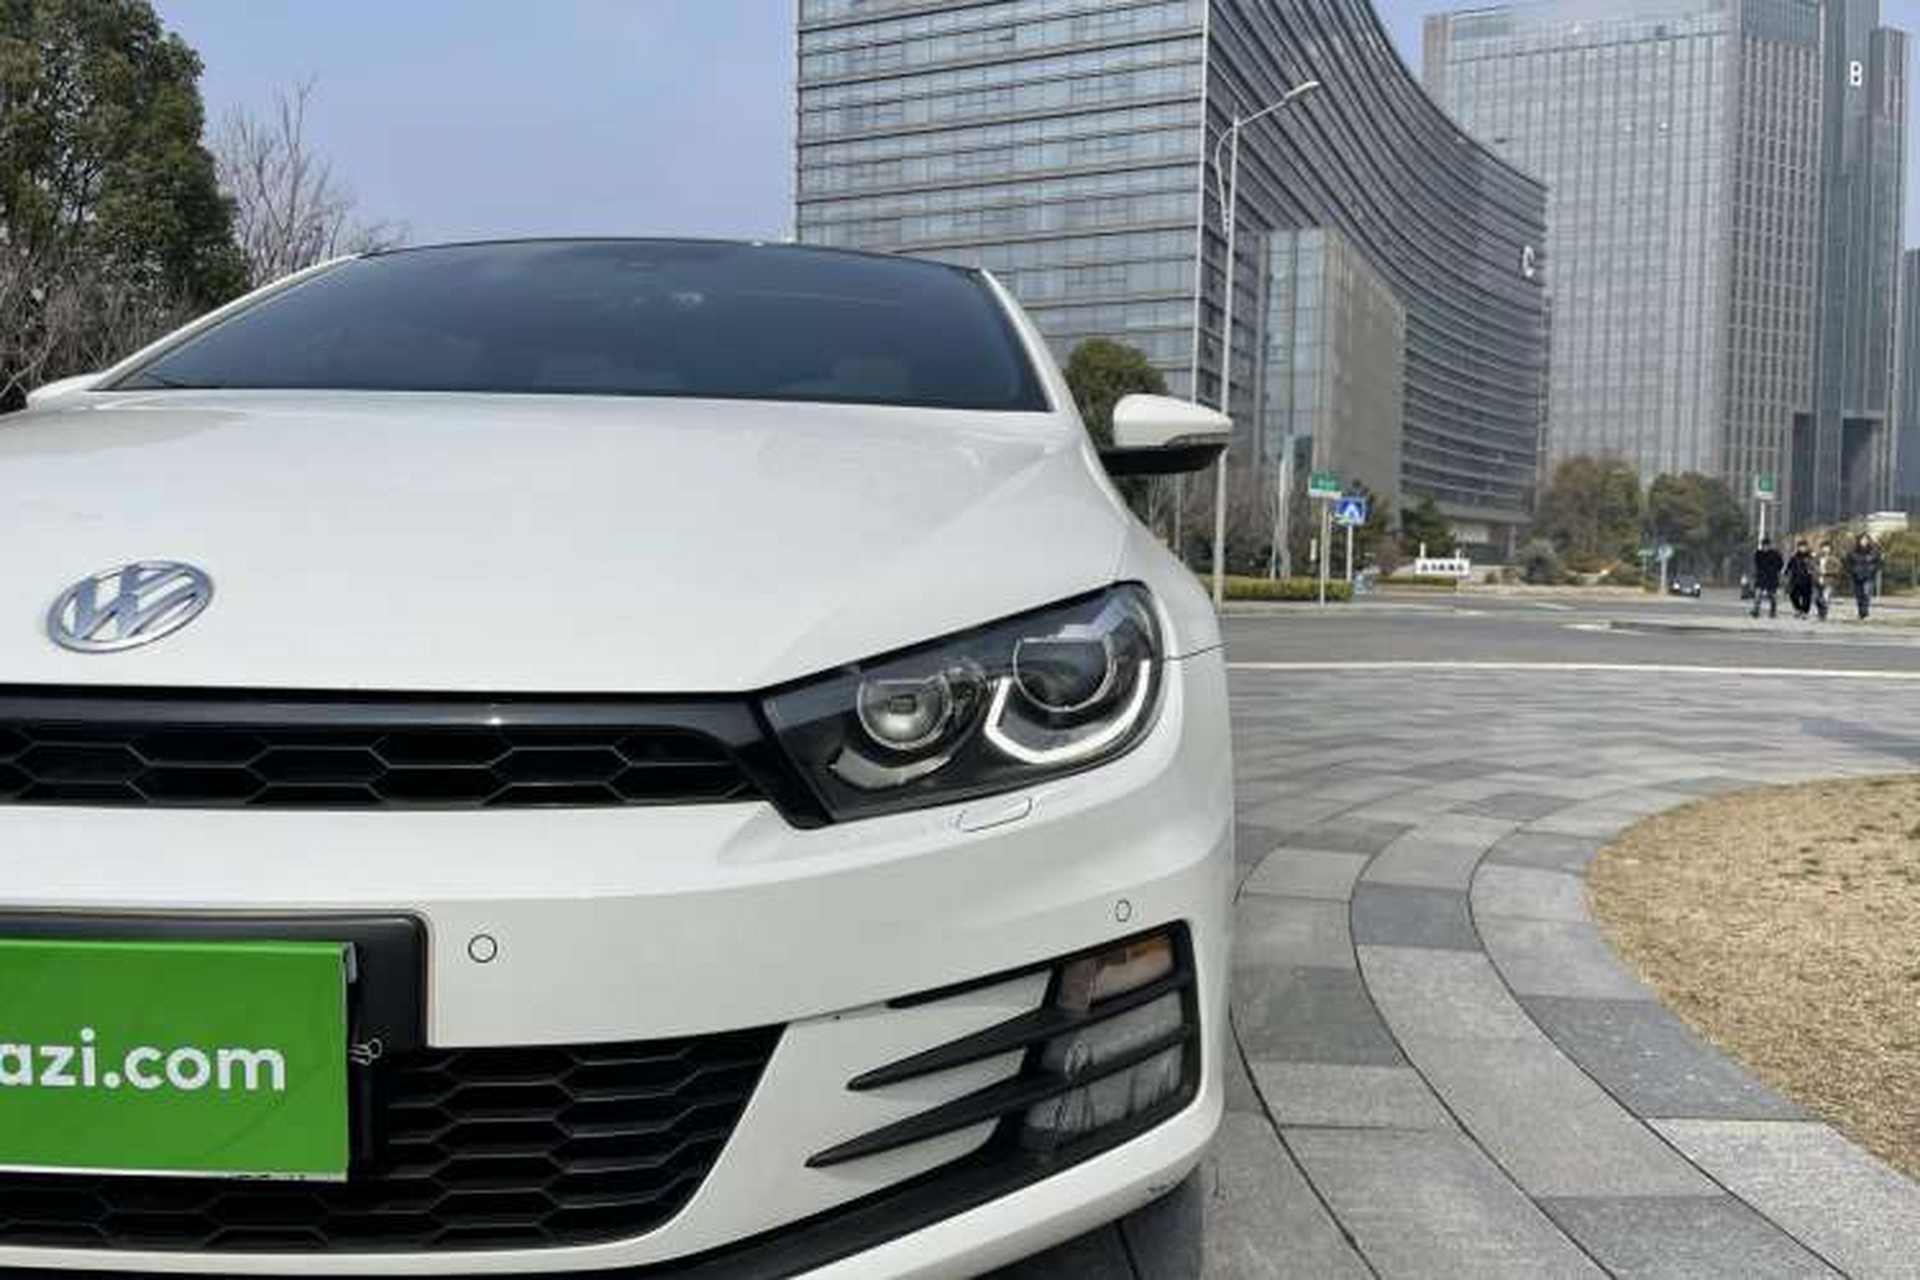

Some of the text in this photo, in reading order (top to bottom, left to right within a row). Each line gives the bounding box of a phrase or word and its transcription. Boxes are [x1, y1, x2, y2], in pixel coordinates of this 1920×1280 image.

[1850, 61, 1862, 86] B
[1523, 245, 1535, 277] C
[0, 1027, 285, 1091] azi.com
